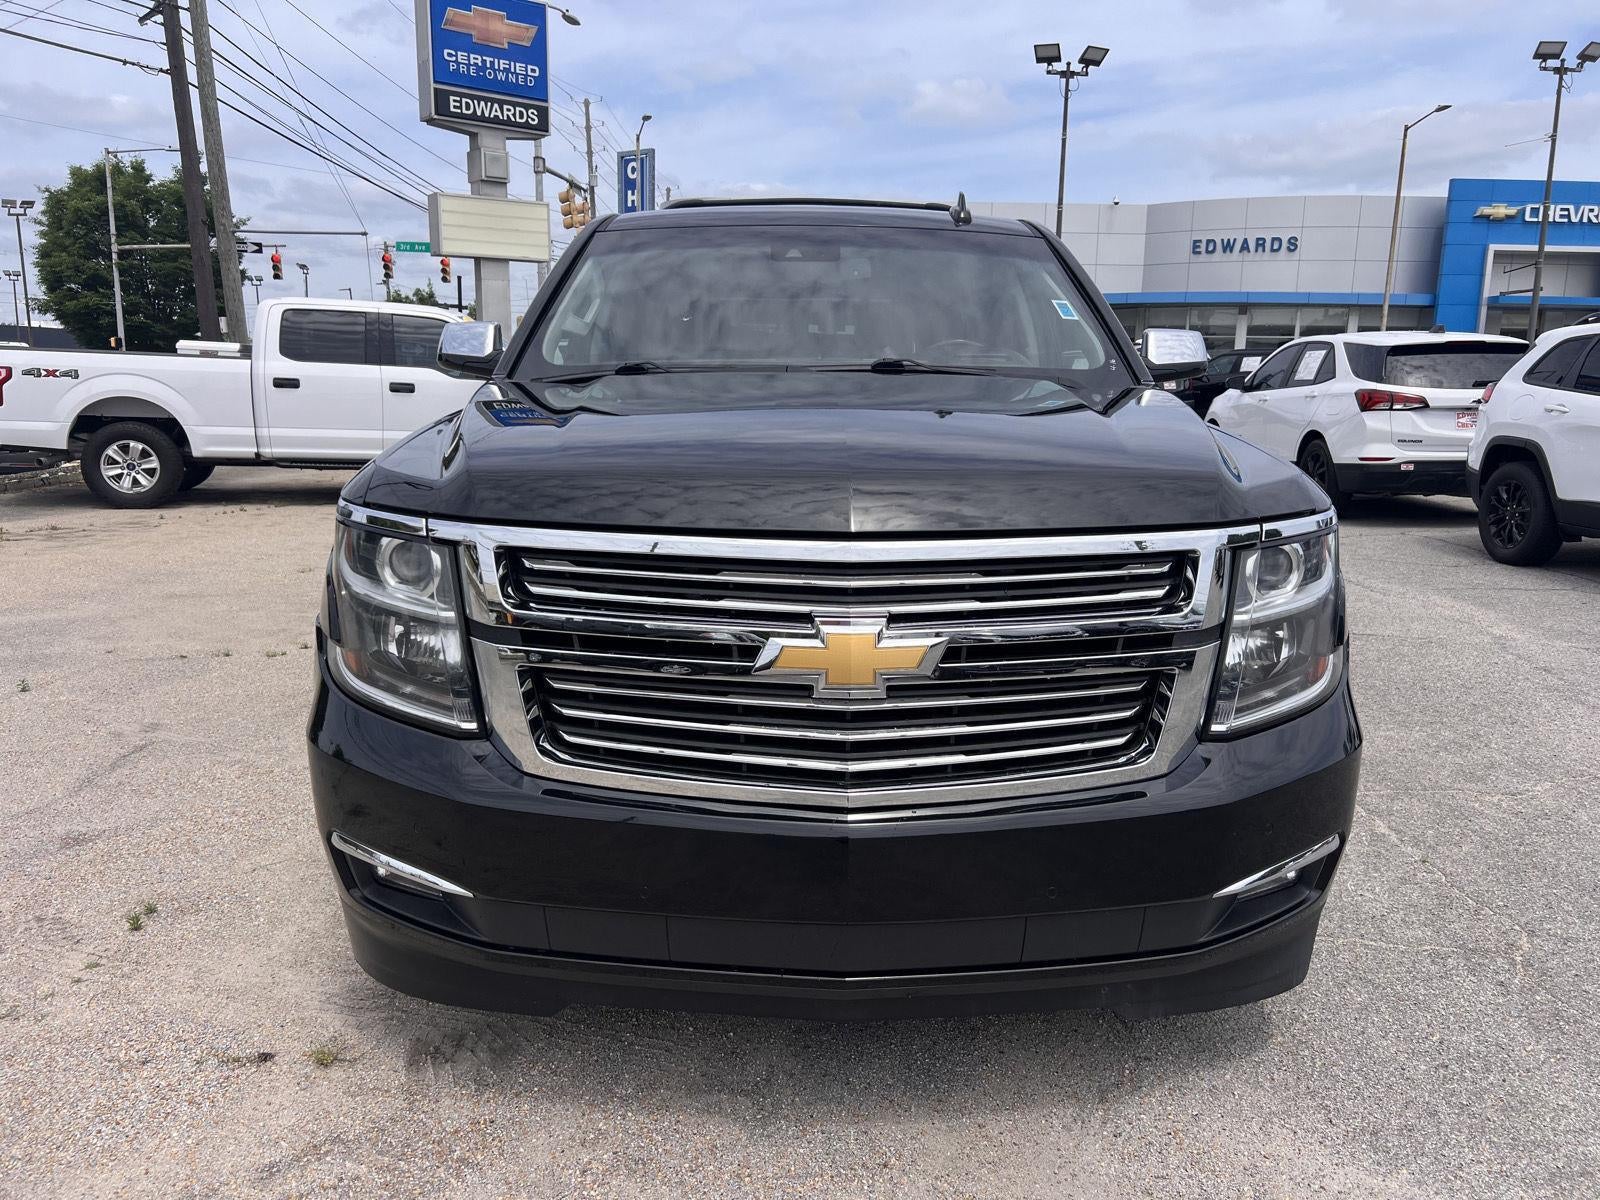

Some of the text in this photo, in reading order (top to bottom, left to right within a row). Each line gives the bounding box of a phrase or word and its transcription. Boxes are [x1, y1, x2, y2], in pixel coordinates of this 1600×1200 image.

[443, 48, 540, 77] CERTIFIED
[449, 62, 535, 87] PRE-OWNED
[449, 95, 539, 125] EDWARDS
[1523, 204, 1600, 223] CHEVR
[1191, 236, 1299, 255] EDWARDS
[1456, 411, 1478, 420] EDWA
